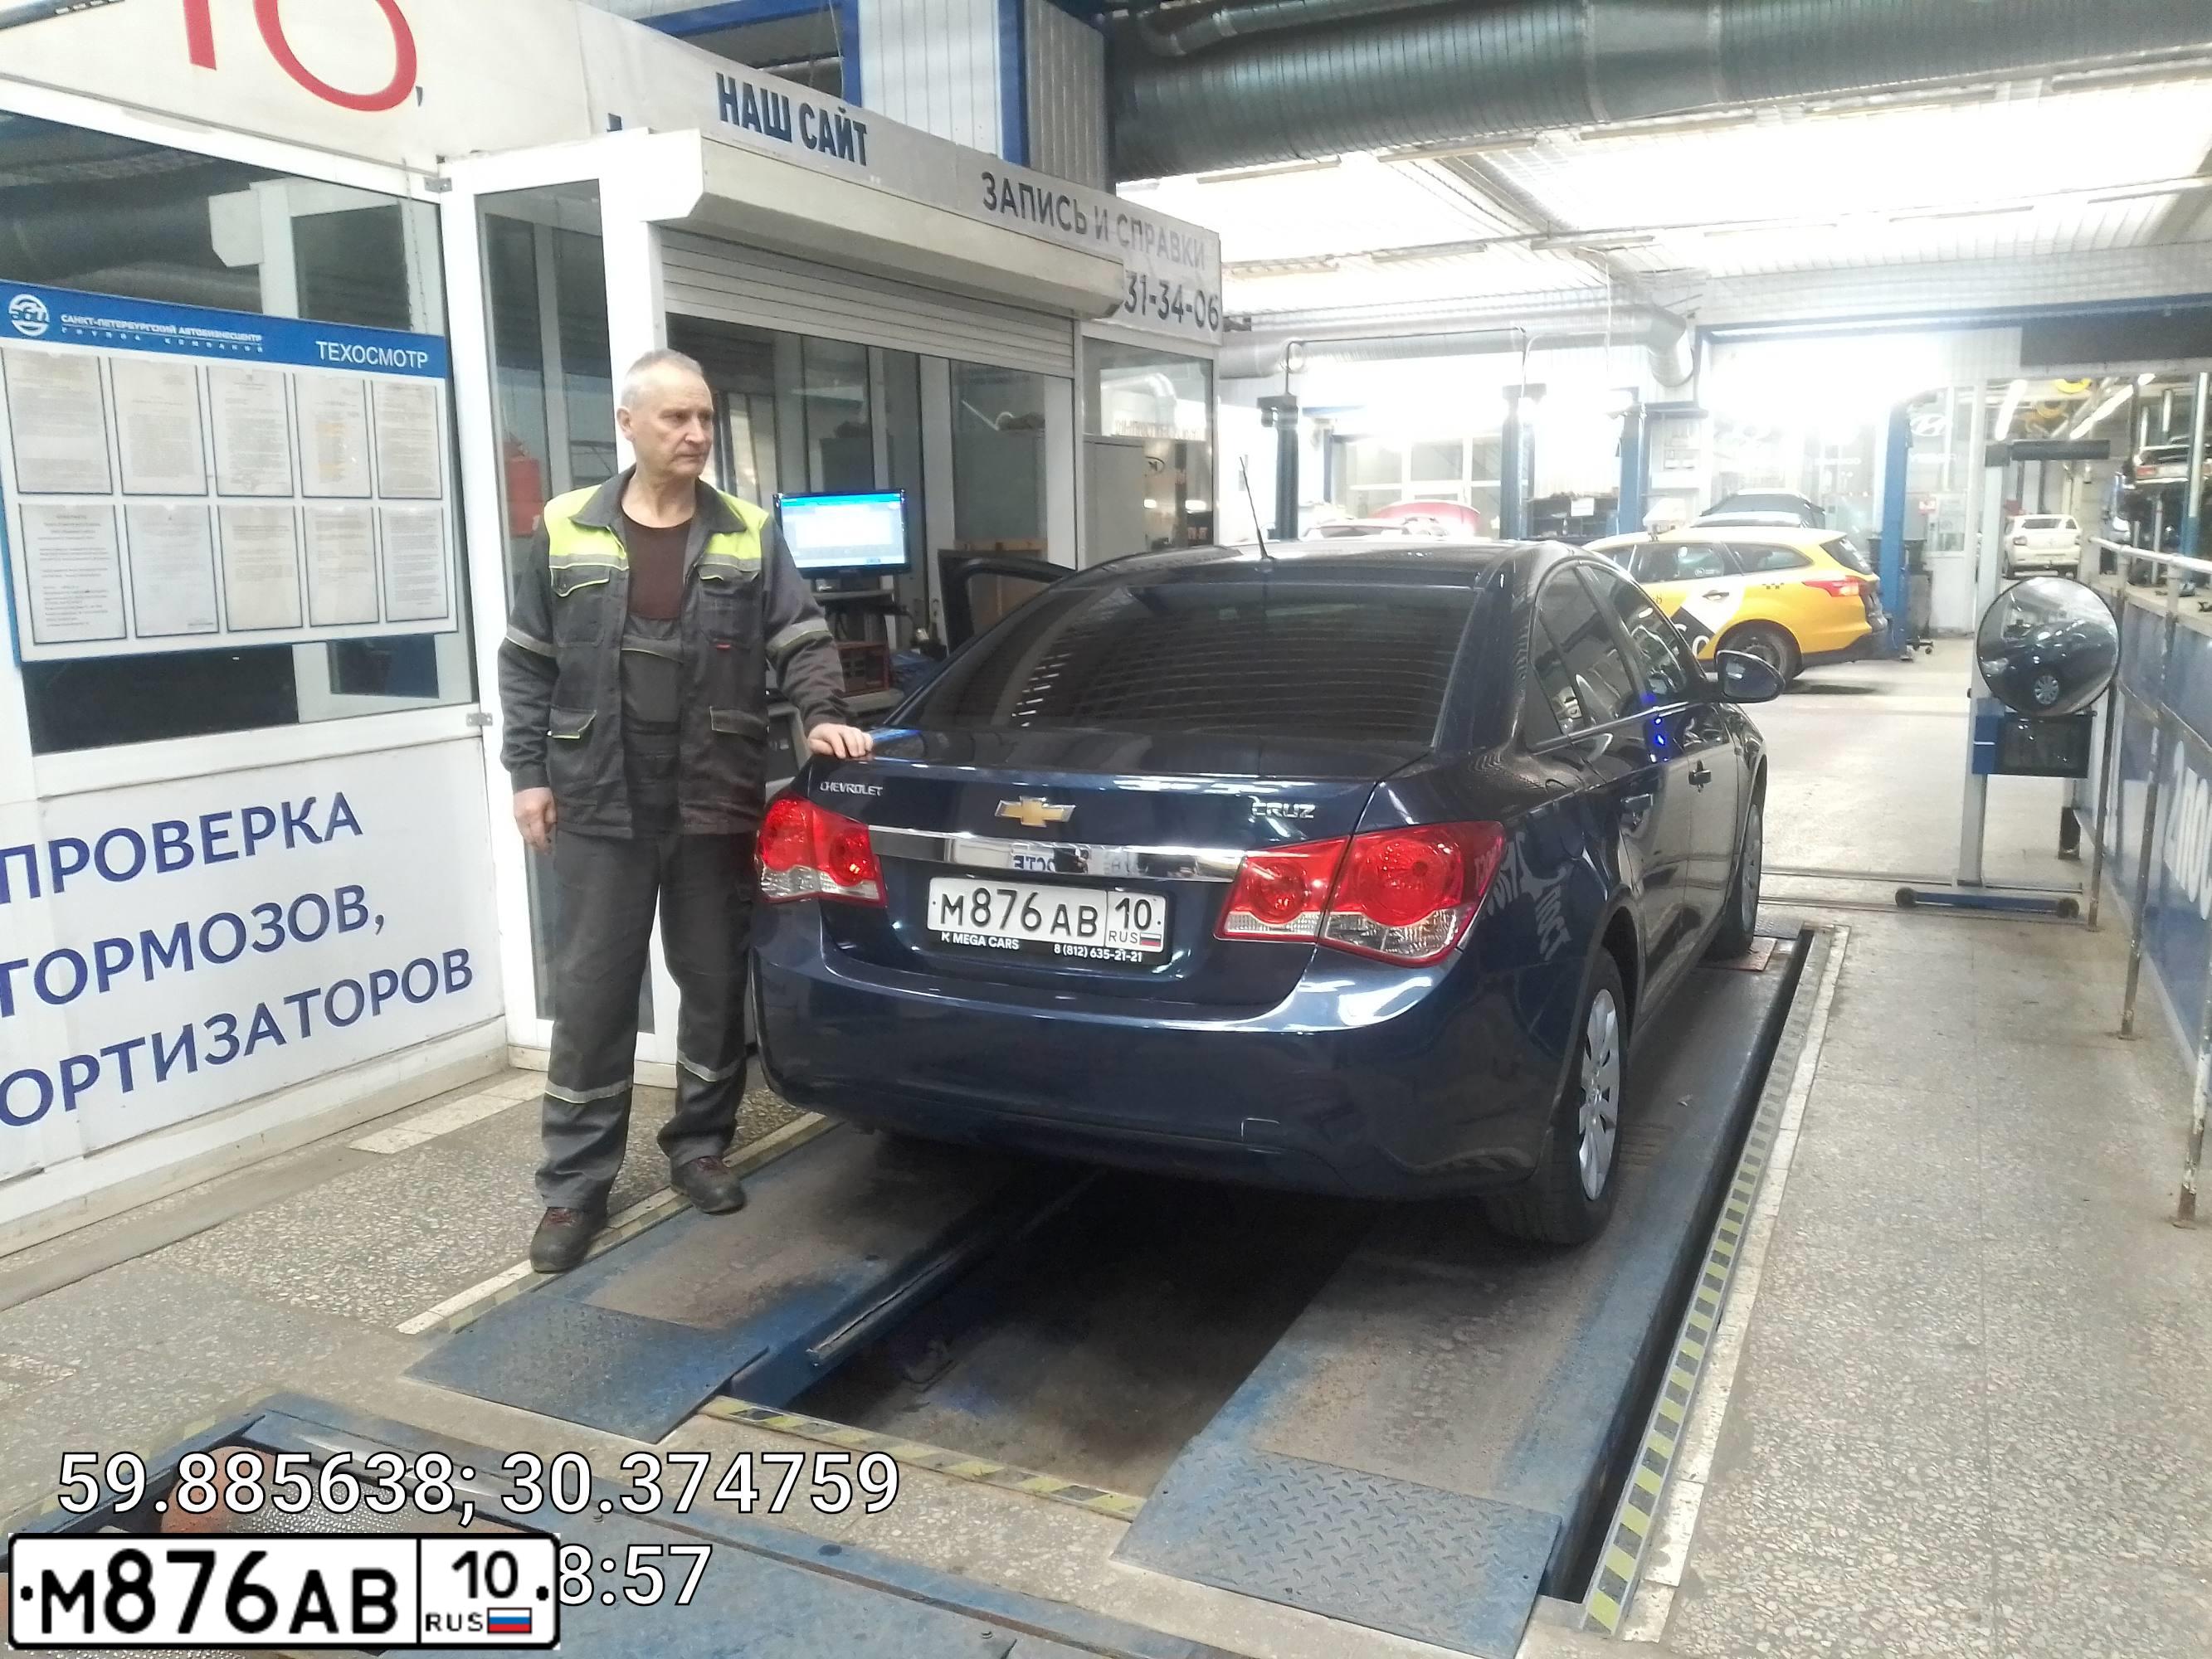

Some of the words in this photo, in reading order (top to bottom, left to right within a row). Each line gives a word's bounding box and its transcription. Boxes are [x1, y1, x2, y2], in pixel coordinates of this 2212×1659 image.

[716, 72, 792, 144] НАШ
[799, 103, 868, 167] САЙТ
[982, 172, 1087, 234] ЗАПИСЬ
[1094, 206, 1109, 242] И
[1117, 214, 1206, 270] СПРАВКИ
[315, 340, 429, 369] ТЕХОСМОТР
[820, 781, 884, 797] CHEVROLET
[1251, 802, 1316, 820] CRUZ
[0, 791, 363, 905] ПРОВЕРКА
[940, 887, 1099, 938] М876АВ
[1114, 898, 1152, 930] 10
[0, 884, 385, 1018] ТОРМОЗОВ,
[953, 933, 987, 947] MEGA
[990, 937, 1020, 951] CARS
[1108, 930, 1138, 943] RUS
[1054, 944, 1061, 954] 8
[1063, 945, 1088, 959] (812)
[1090, 948, 1143, 963] 635-21-21
